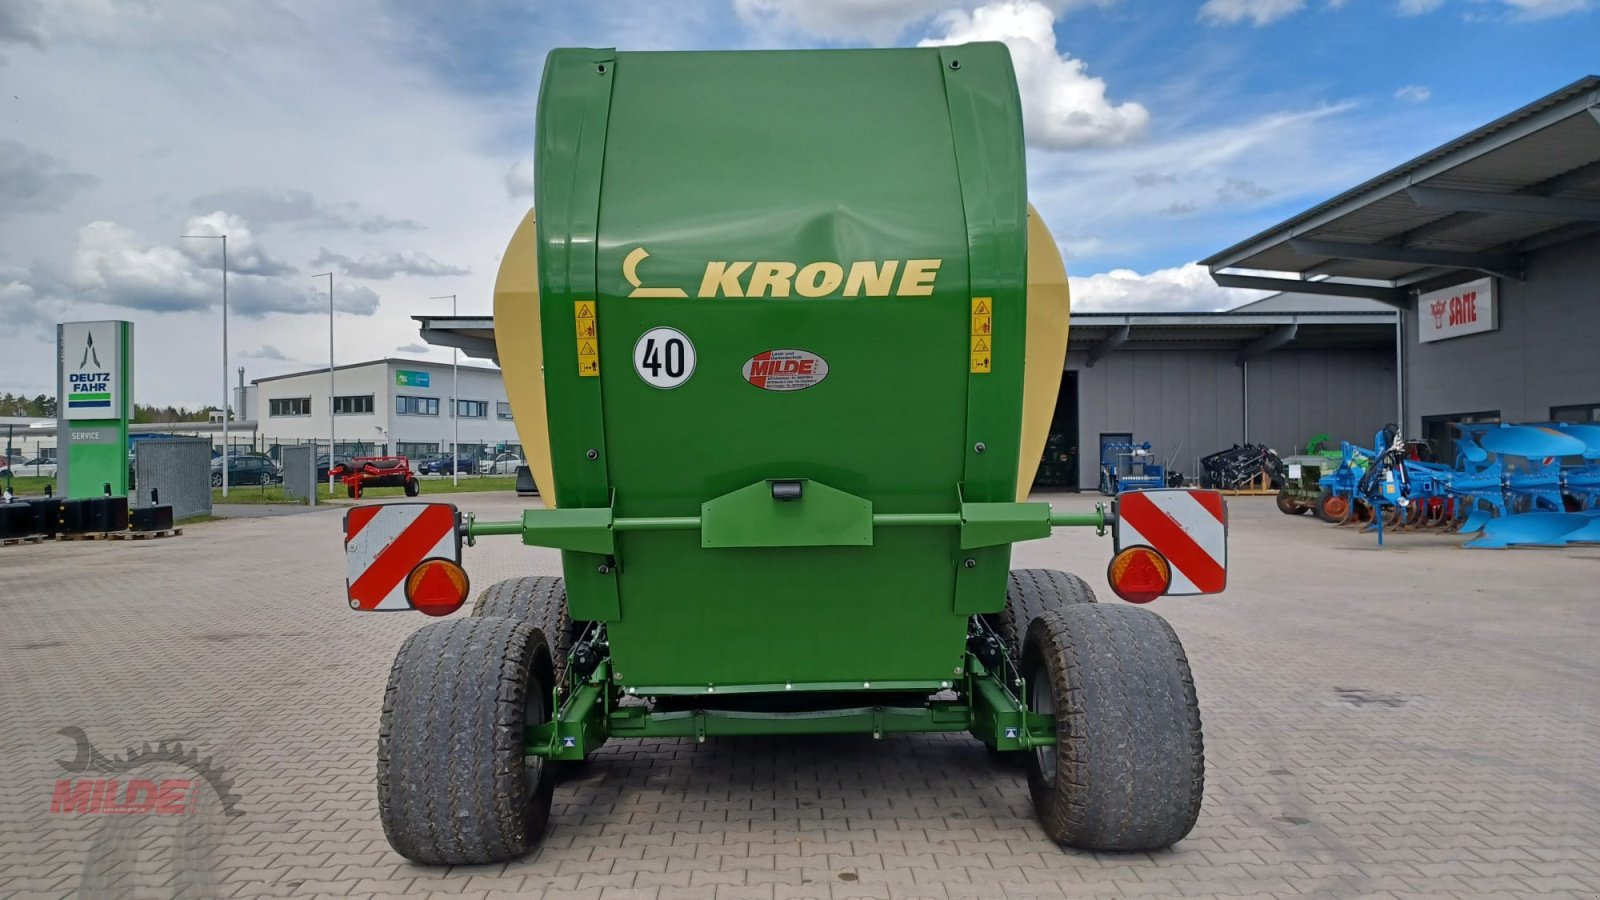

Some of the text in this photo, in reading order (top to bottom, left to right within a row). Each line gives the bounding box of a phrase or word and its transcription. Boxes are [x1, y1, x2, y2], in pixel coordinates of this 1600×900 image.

[697, 259, 942, 298] KRONE
[1449, 291, 1477, 327] SAME
[642, 338, 685, 378] 40
[750, 360, 814, 376] MILDE
[69, 373, 111, 382] DEUTZ
[73, 383, 107, 392] FAHR
[71, 432, 100, 440] SERVICE
